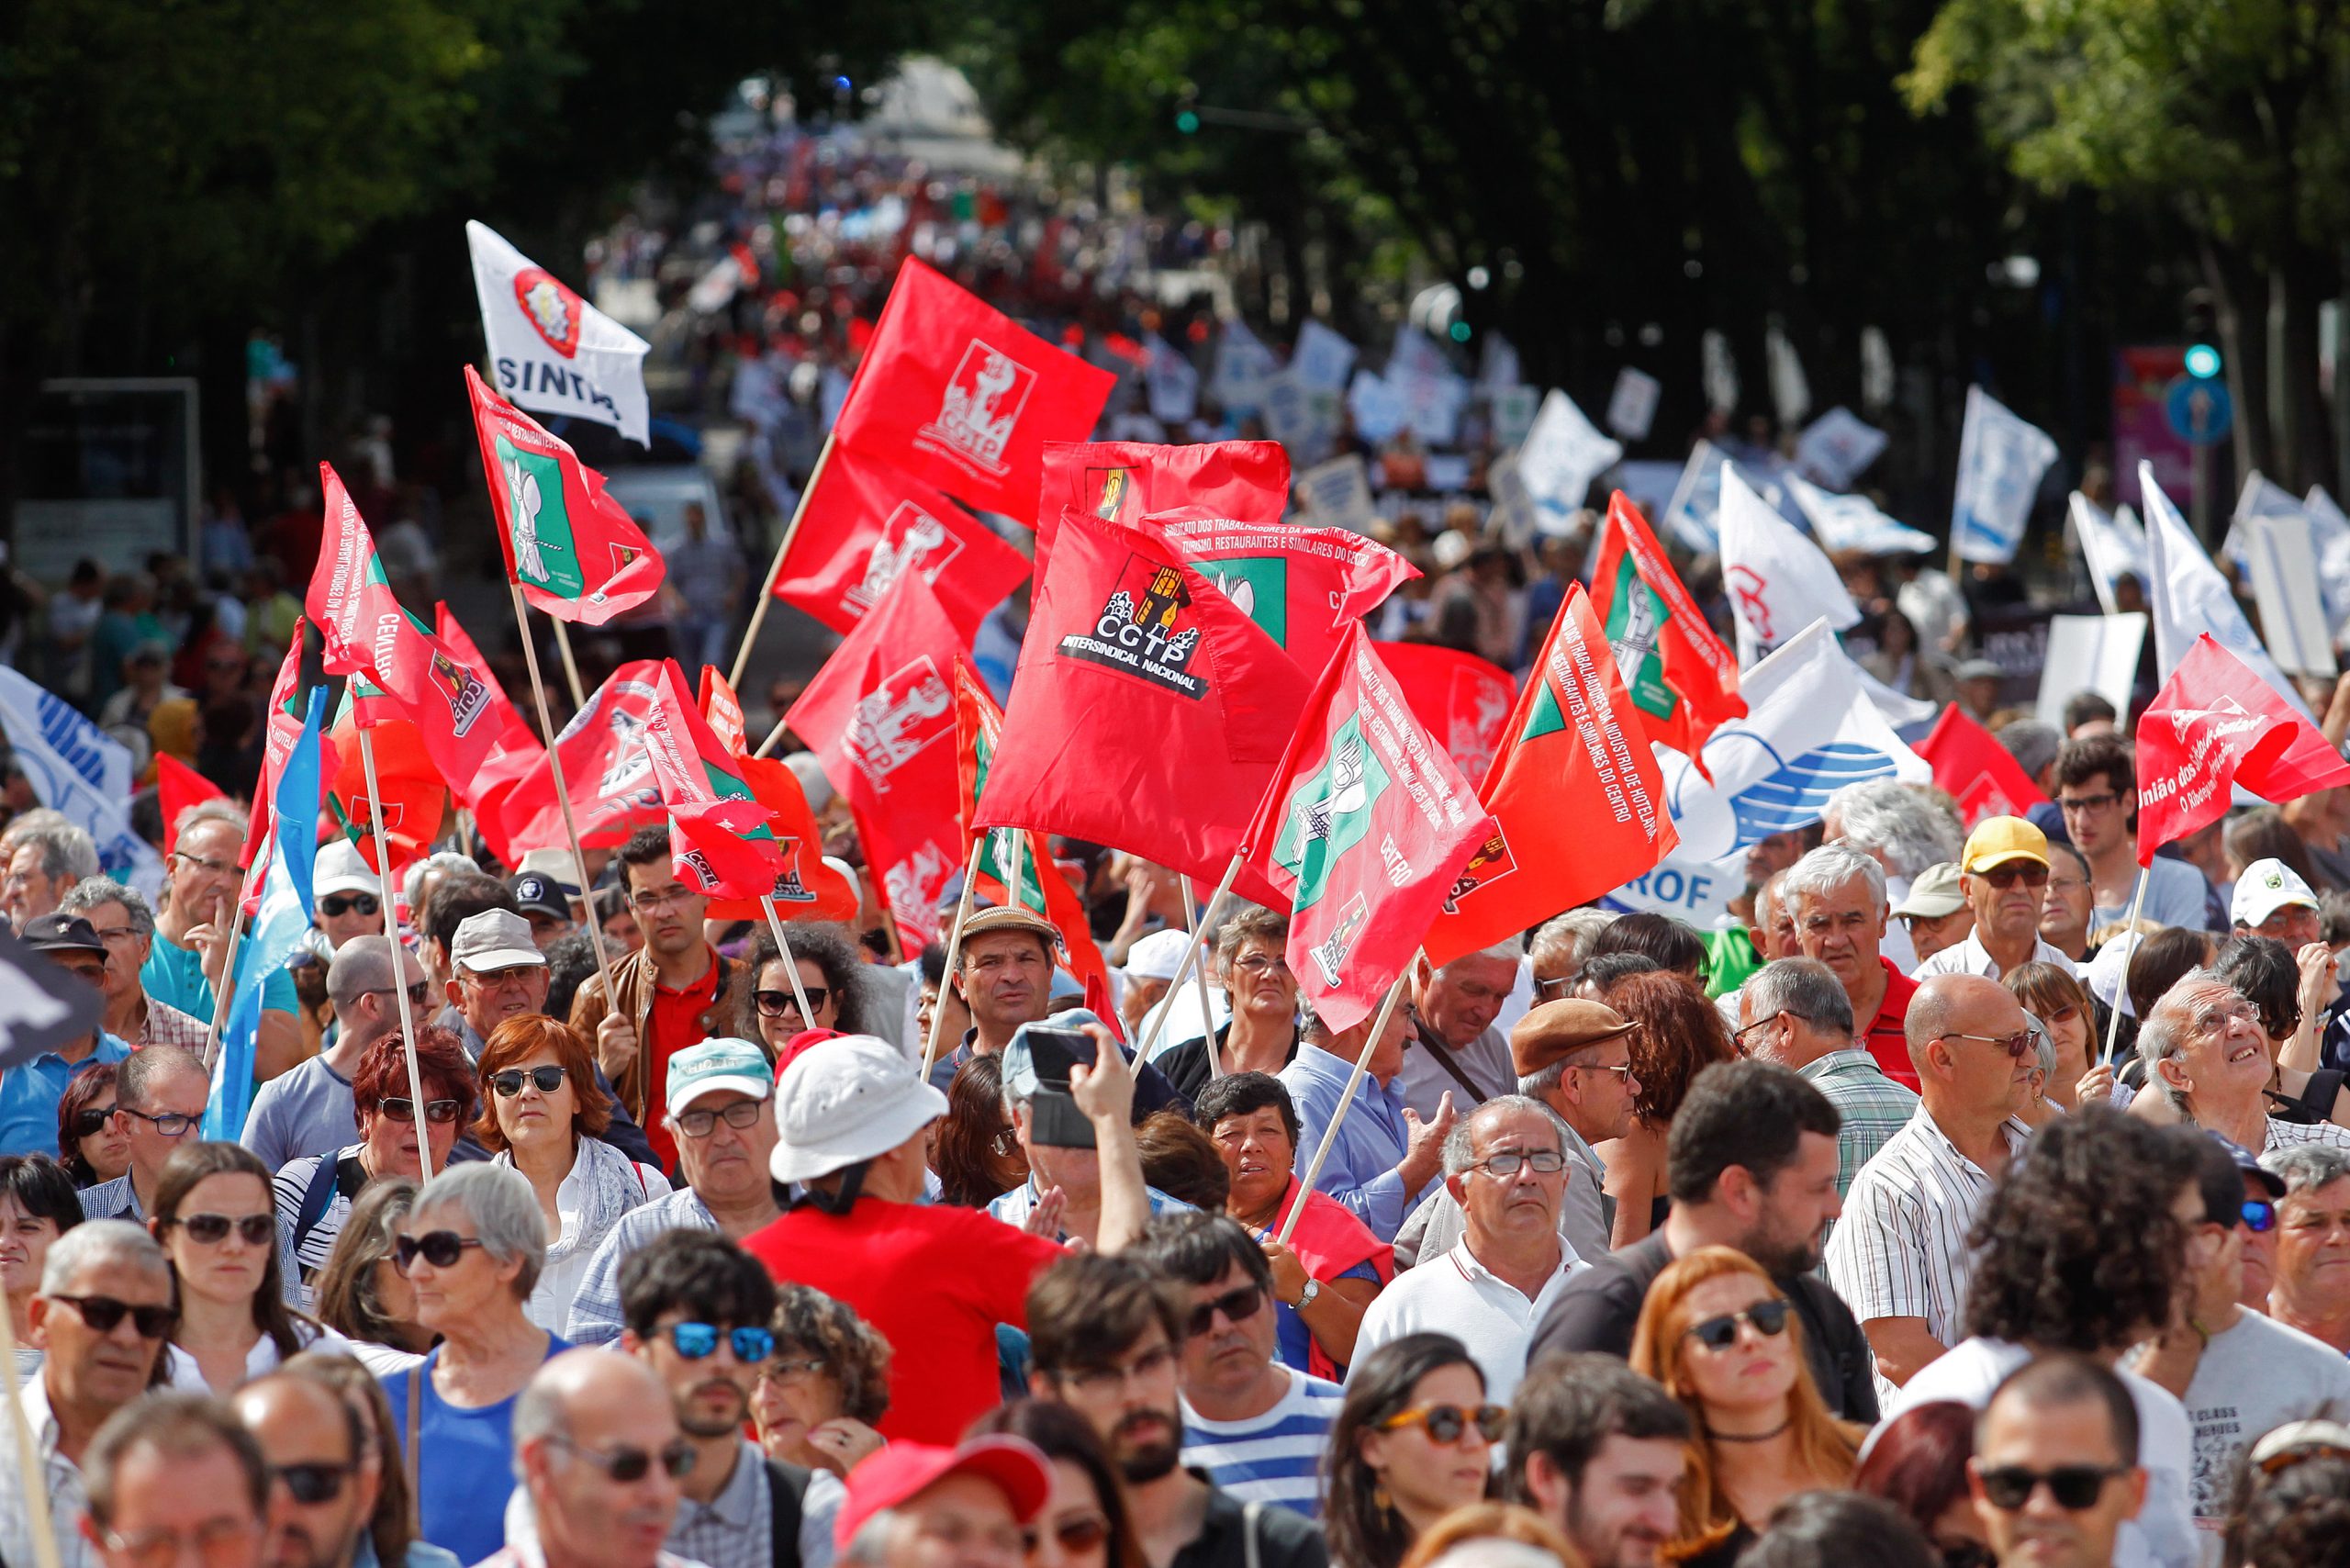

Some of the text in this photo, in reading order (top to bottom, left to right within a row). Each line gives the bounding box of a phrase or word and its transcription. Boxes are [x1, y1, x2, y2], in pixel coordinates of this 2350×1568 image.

[1197, 520, 1213, 532] DOS
[1214, 519, 1286, 534] TRABALHADORES
[1288, 526, 1300, 534] DA
[1182, 537, 1214, 554] TURISMO,
[1215, 535, 1279, 551] RESTAURANTES
[1281, 537, 1286, 548] E
[1288, 536, 1333, 558] SIMILARES
[1335, 545, 1347, 562] DO
[1097, 615, 1185, 664] CGTP
[1061, 635, 1195, 690] INTERSINDICAL NACIONAL
[1571, 641, 1609, 713] TRABALHADORES
[1550, 652, 1586, 717] RESTAURANTES
[1372, 684, 1388, 706] DOS
[1413, 748, 1427, 766] DA
[1575, 713, 1589, 723] E
[1599, 708, 1615, 726] DA
[1578, 720, 1610, 769] SIMILARES
[1605, 722, 1636, 775] INDÚSTRIA
[1397, 763, 1425, 804] SIMILARES
[1598, 767, 1616, 783] DO
[1623, 772, 1640, 790] DE
[2177, 762, 2197, 789] dos
[1605, 781, 1632, 823] CENTRO
[1629, 787, 1659, 844] HOTELARIA,
[2179, 795, 2188, 813] O
[1380, 832, 1414, 888] CENTRO
